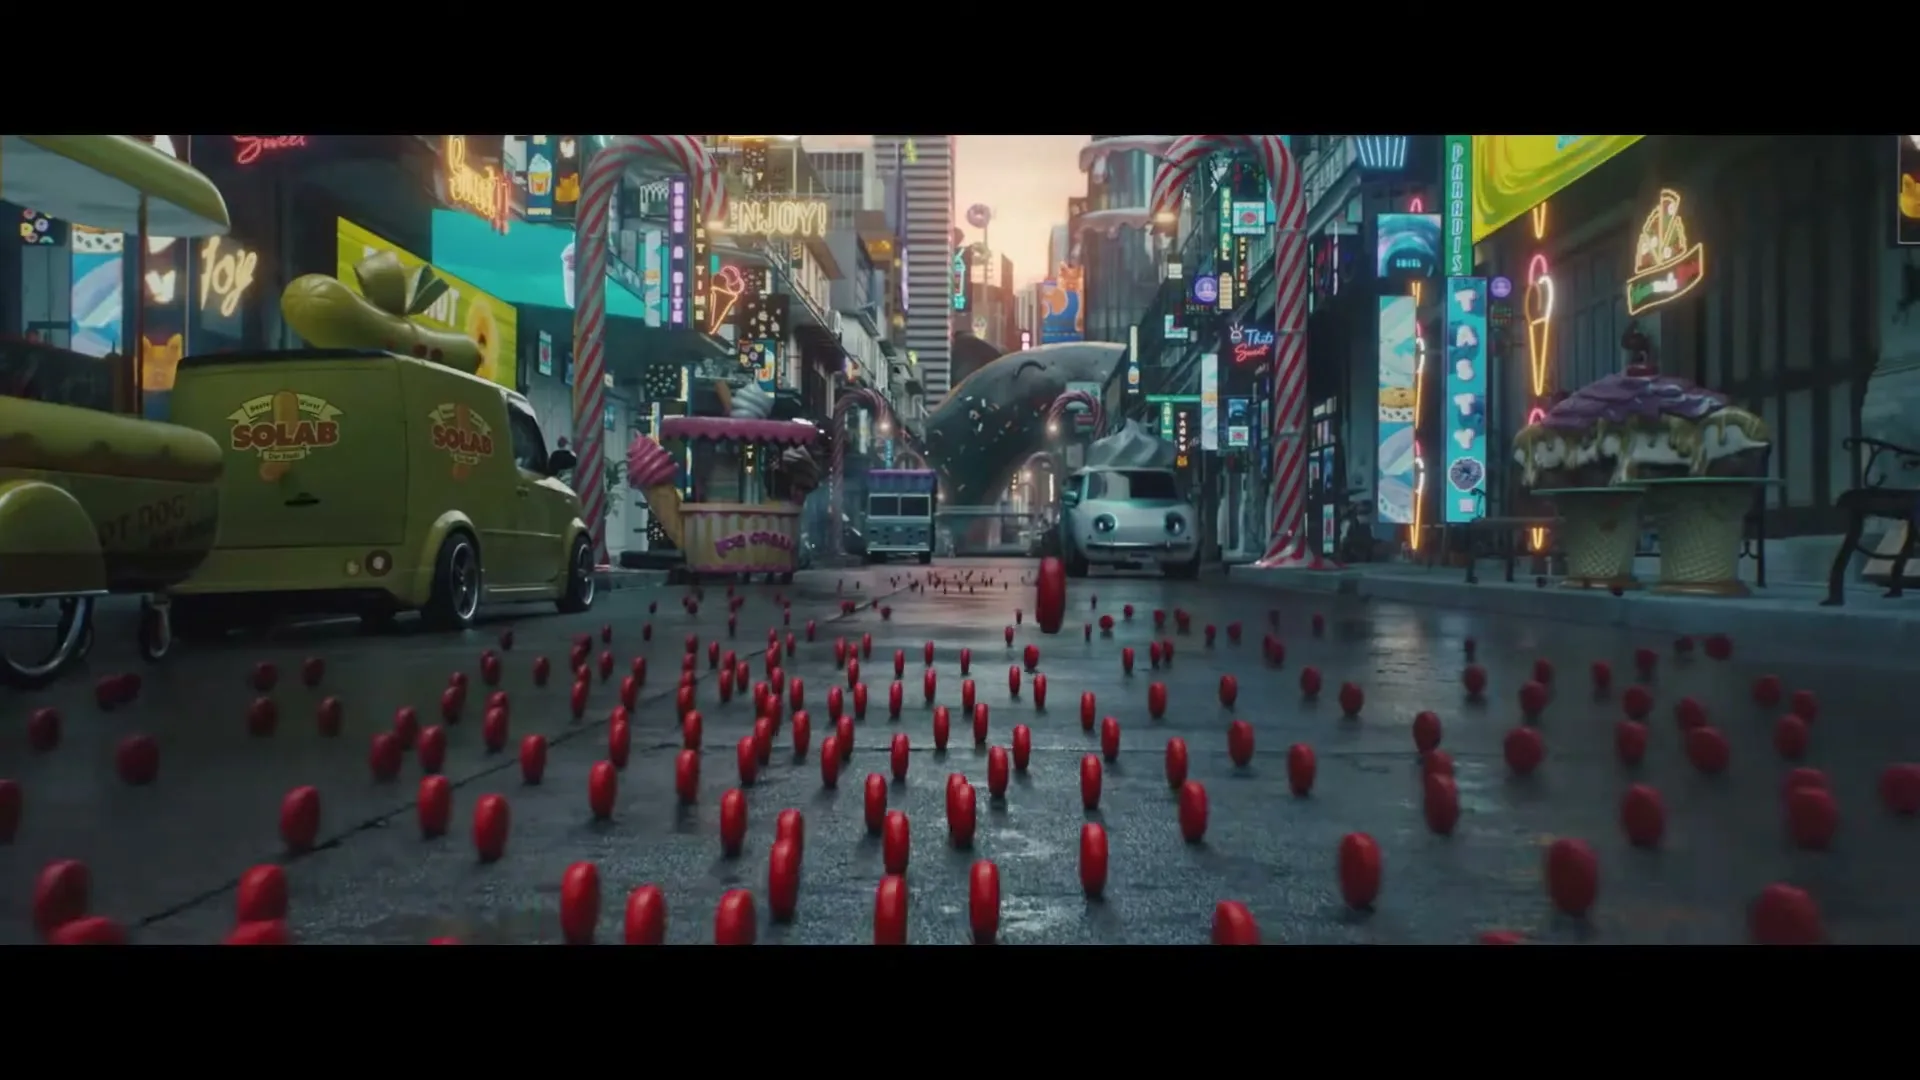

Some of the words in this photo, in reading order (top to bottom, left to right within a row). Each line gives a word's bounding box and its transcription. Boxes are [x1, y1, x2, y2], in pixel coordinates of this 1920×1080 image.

[1451, 142, 1464, 275] PARADIS
[1455, 288, 1478, 449] TASTY
[231, 420, 340, 450] SOLAB
[431, 422, 494, 457] SOLAB
